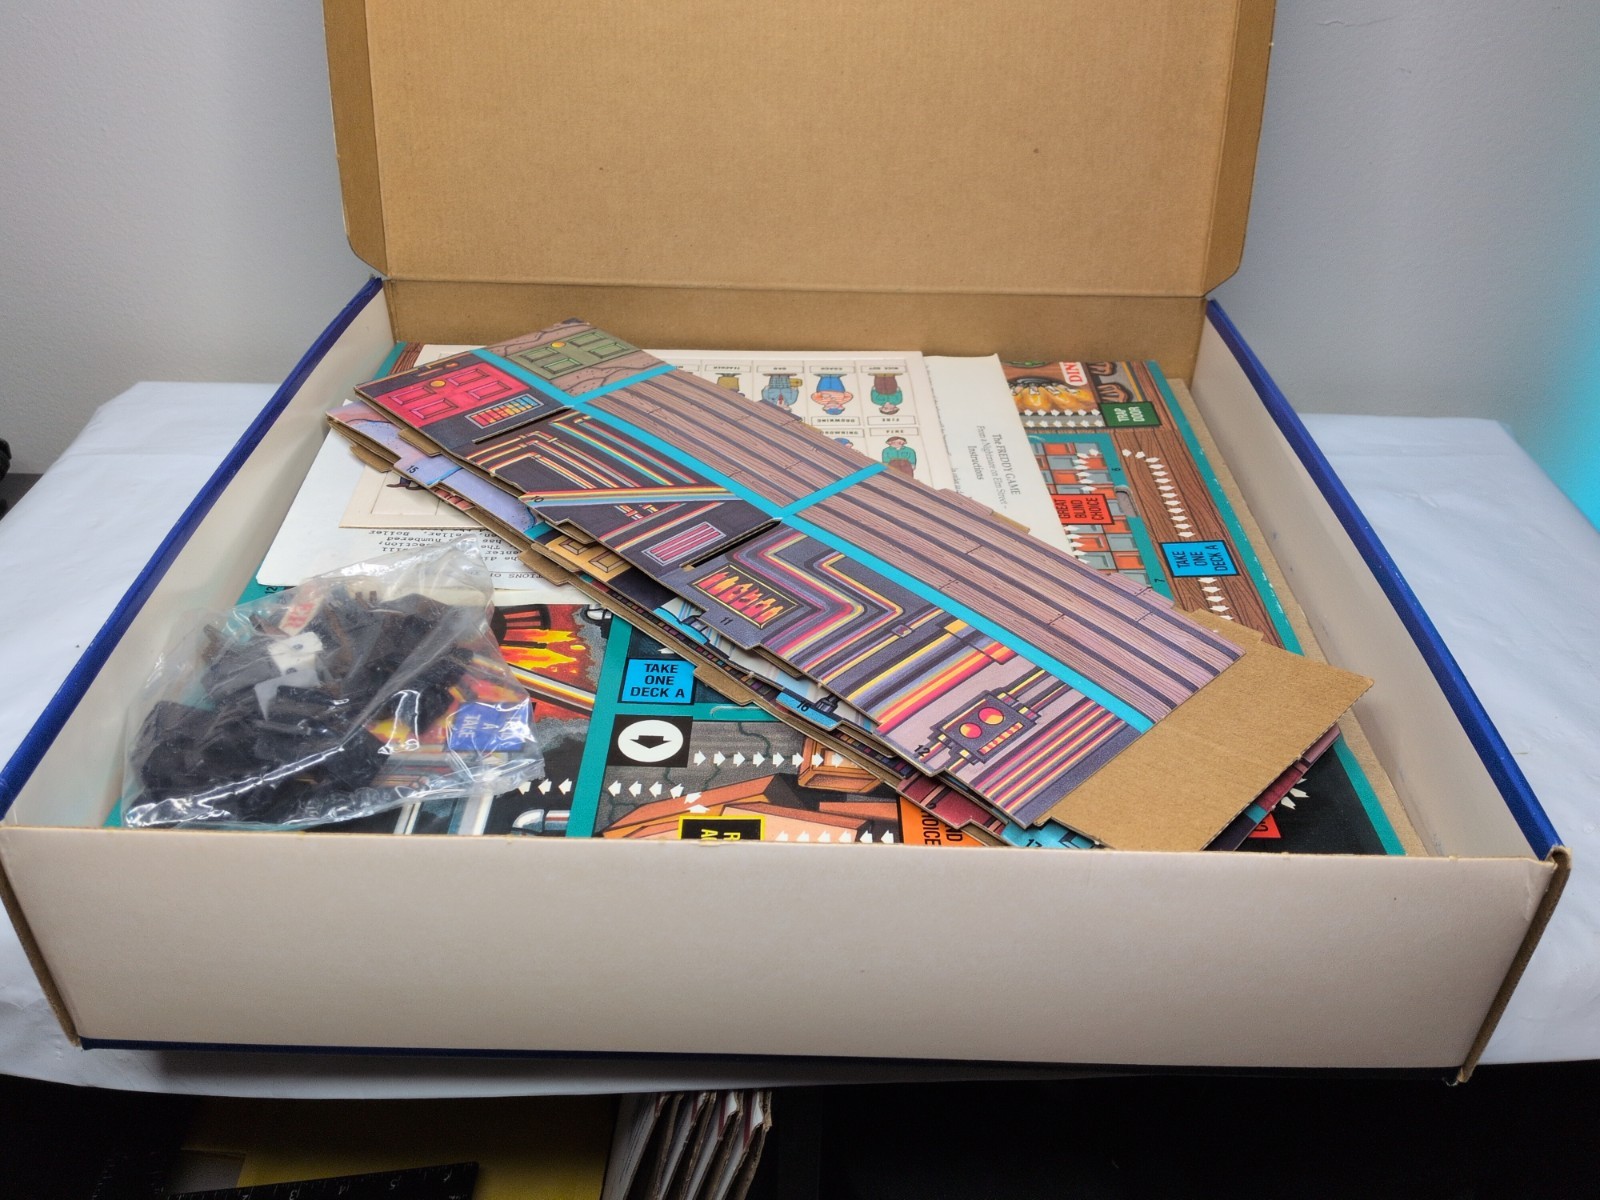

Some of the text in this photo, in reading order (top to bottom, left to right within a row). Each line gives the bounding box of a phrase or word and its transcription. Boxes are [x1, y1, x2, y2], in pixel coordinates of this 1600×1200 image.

[1114, 407, 1130, 422] TRAP
[1128, 406, 1145, 422] DOOR
[406, 464, 419, 474] 15
[967, 445, 985, 480] Instructions
[992, 434, 1021, 495] The FREDDY GAME
[1053, 499, 1071, 519] GREAT
[1070, 499, 1087, 519] BLIND
[1085, 497, 1104, 521] CHOICE
[1171, 551, 1190, 569] TAKE
[1190, 551, 1208, 567] ONE
[1207, 552, 1228, 571] DECK
[720, 616, 734, 626] 11
[644, 663, 679, 674] TAKE
[644, 674, 675, 686] ONE
[630, 686, 685, 698] DECK A
[796, 702, 810, 712] 16
[914, 744, 931, 758] 12
